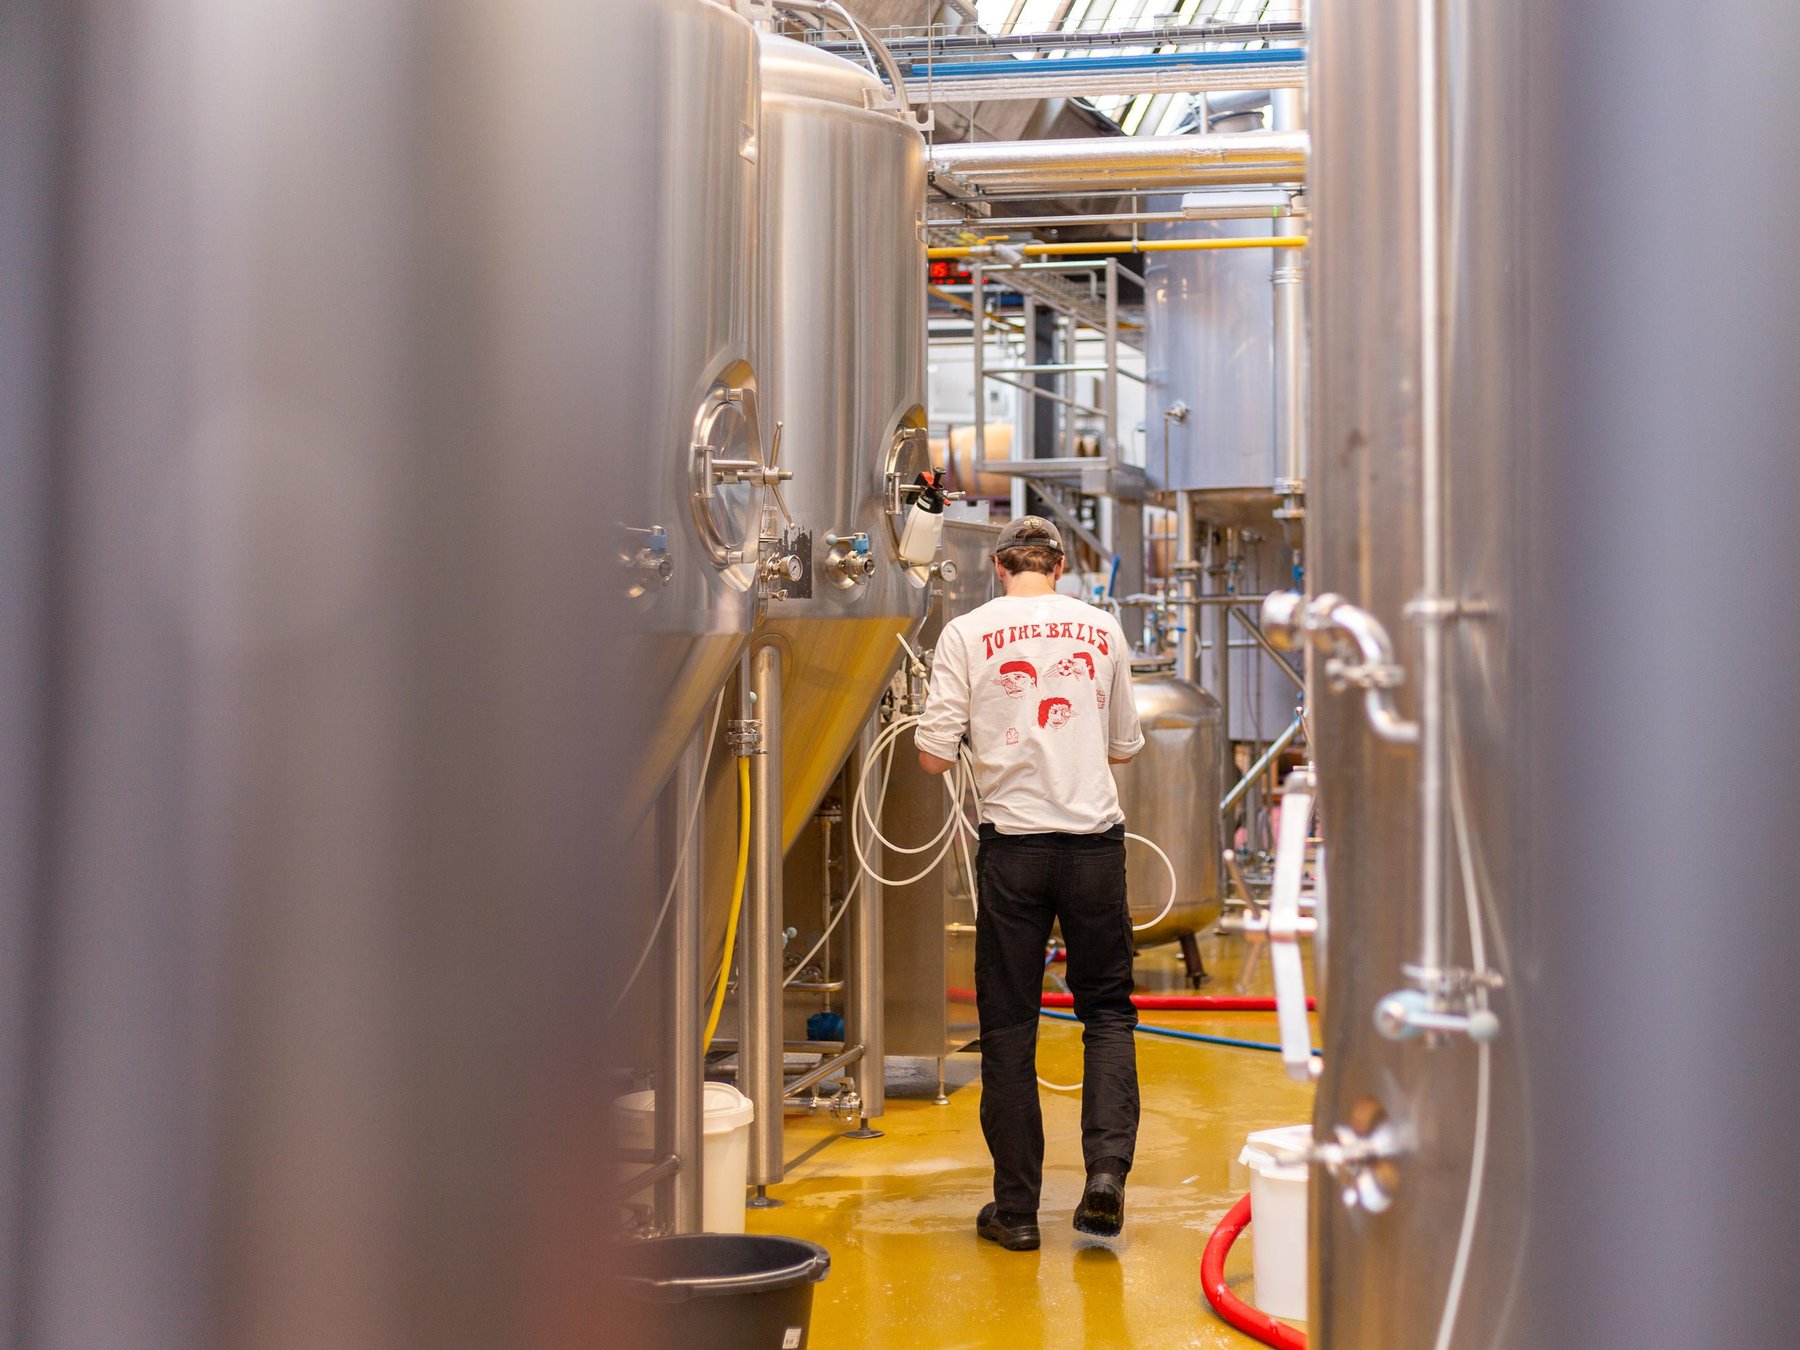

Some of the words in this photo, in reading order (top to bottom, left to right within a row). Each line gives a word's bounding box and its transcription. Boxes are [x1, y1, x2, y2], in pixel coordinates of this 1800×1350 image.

[982, 629, 1005, 660] TO
[1009, 624, 1041, 643] THE
[1046, 622, 1109, 656] BALLS
